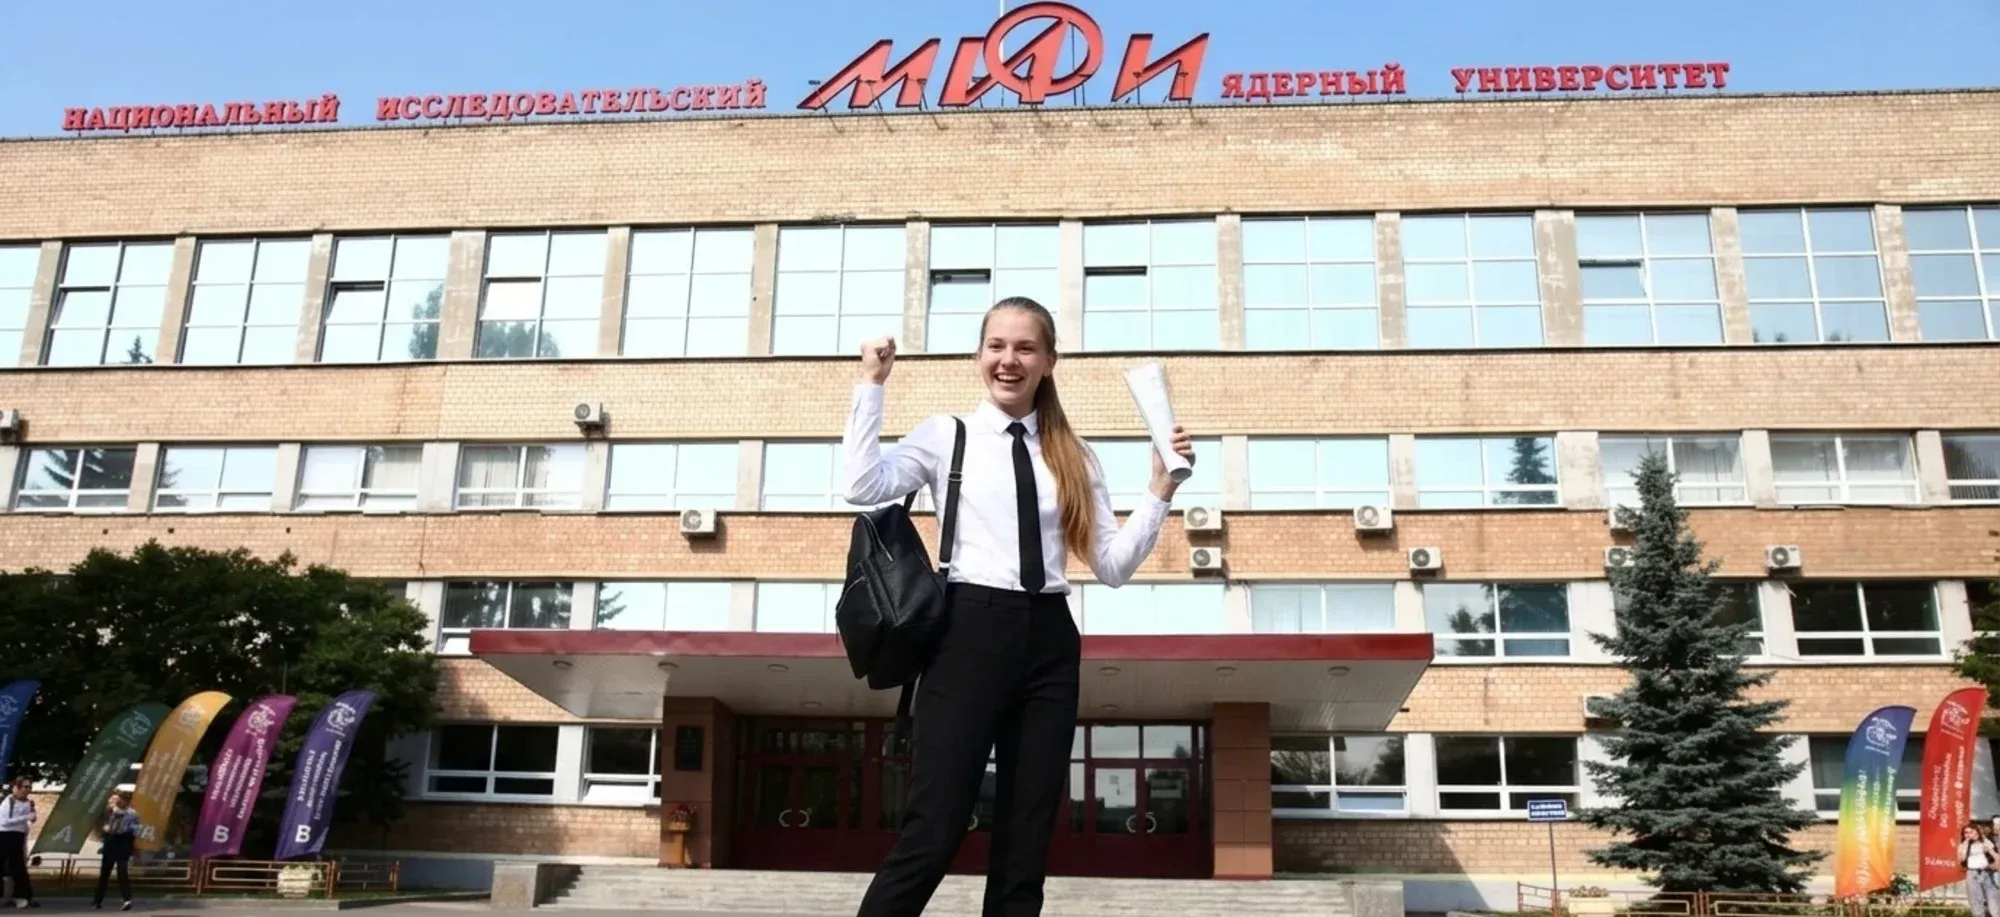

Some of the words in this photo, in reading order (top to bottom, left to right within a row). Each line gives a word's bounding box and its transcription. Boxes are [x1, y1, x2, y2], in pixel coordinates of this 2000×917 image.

[62, 94, 340, 132] НАЦИОНАЛЬНЫЙ
[376, 78, 767, 121] ИССЛЕДОВАТЕЛЬСКИЙ
[1221, 63, 1406, 101] ЯДЕРНЫЙ
[1451, 62, 1730, 93] УНИВЕРСИТЕТ
[797, 1, 1209, 109] МИФИ
